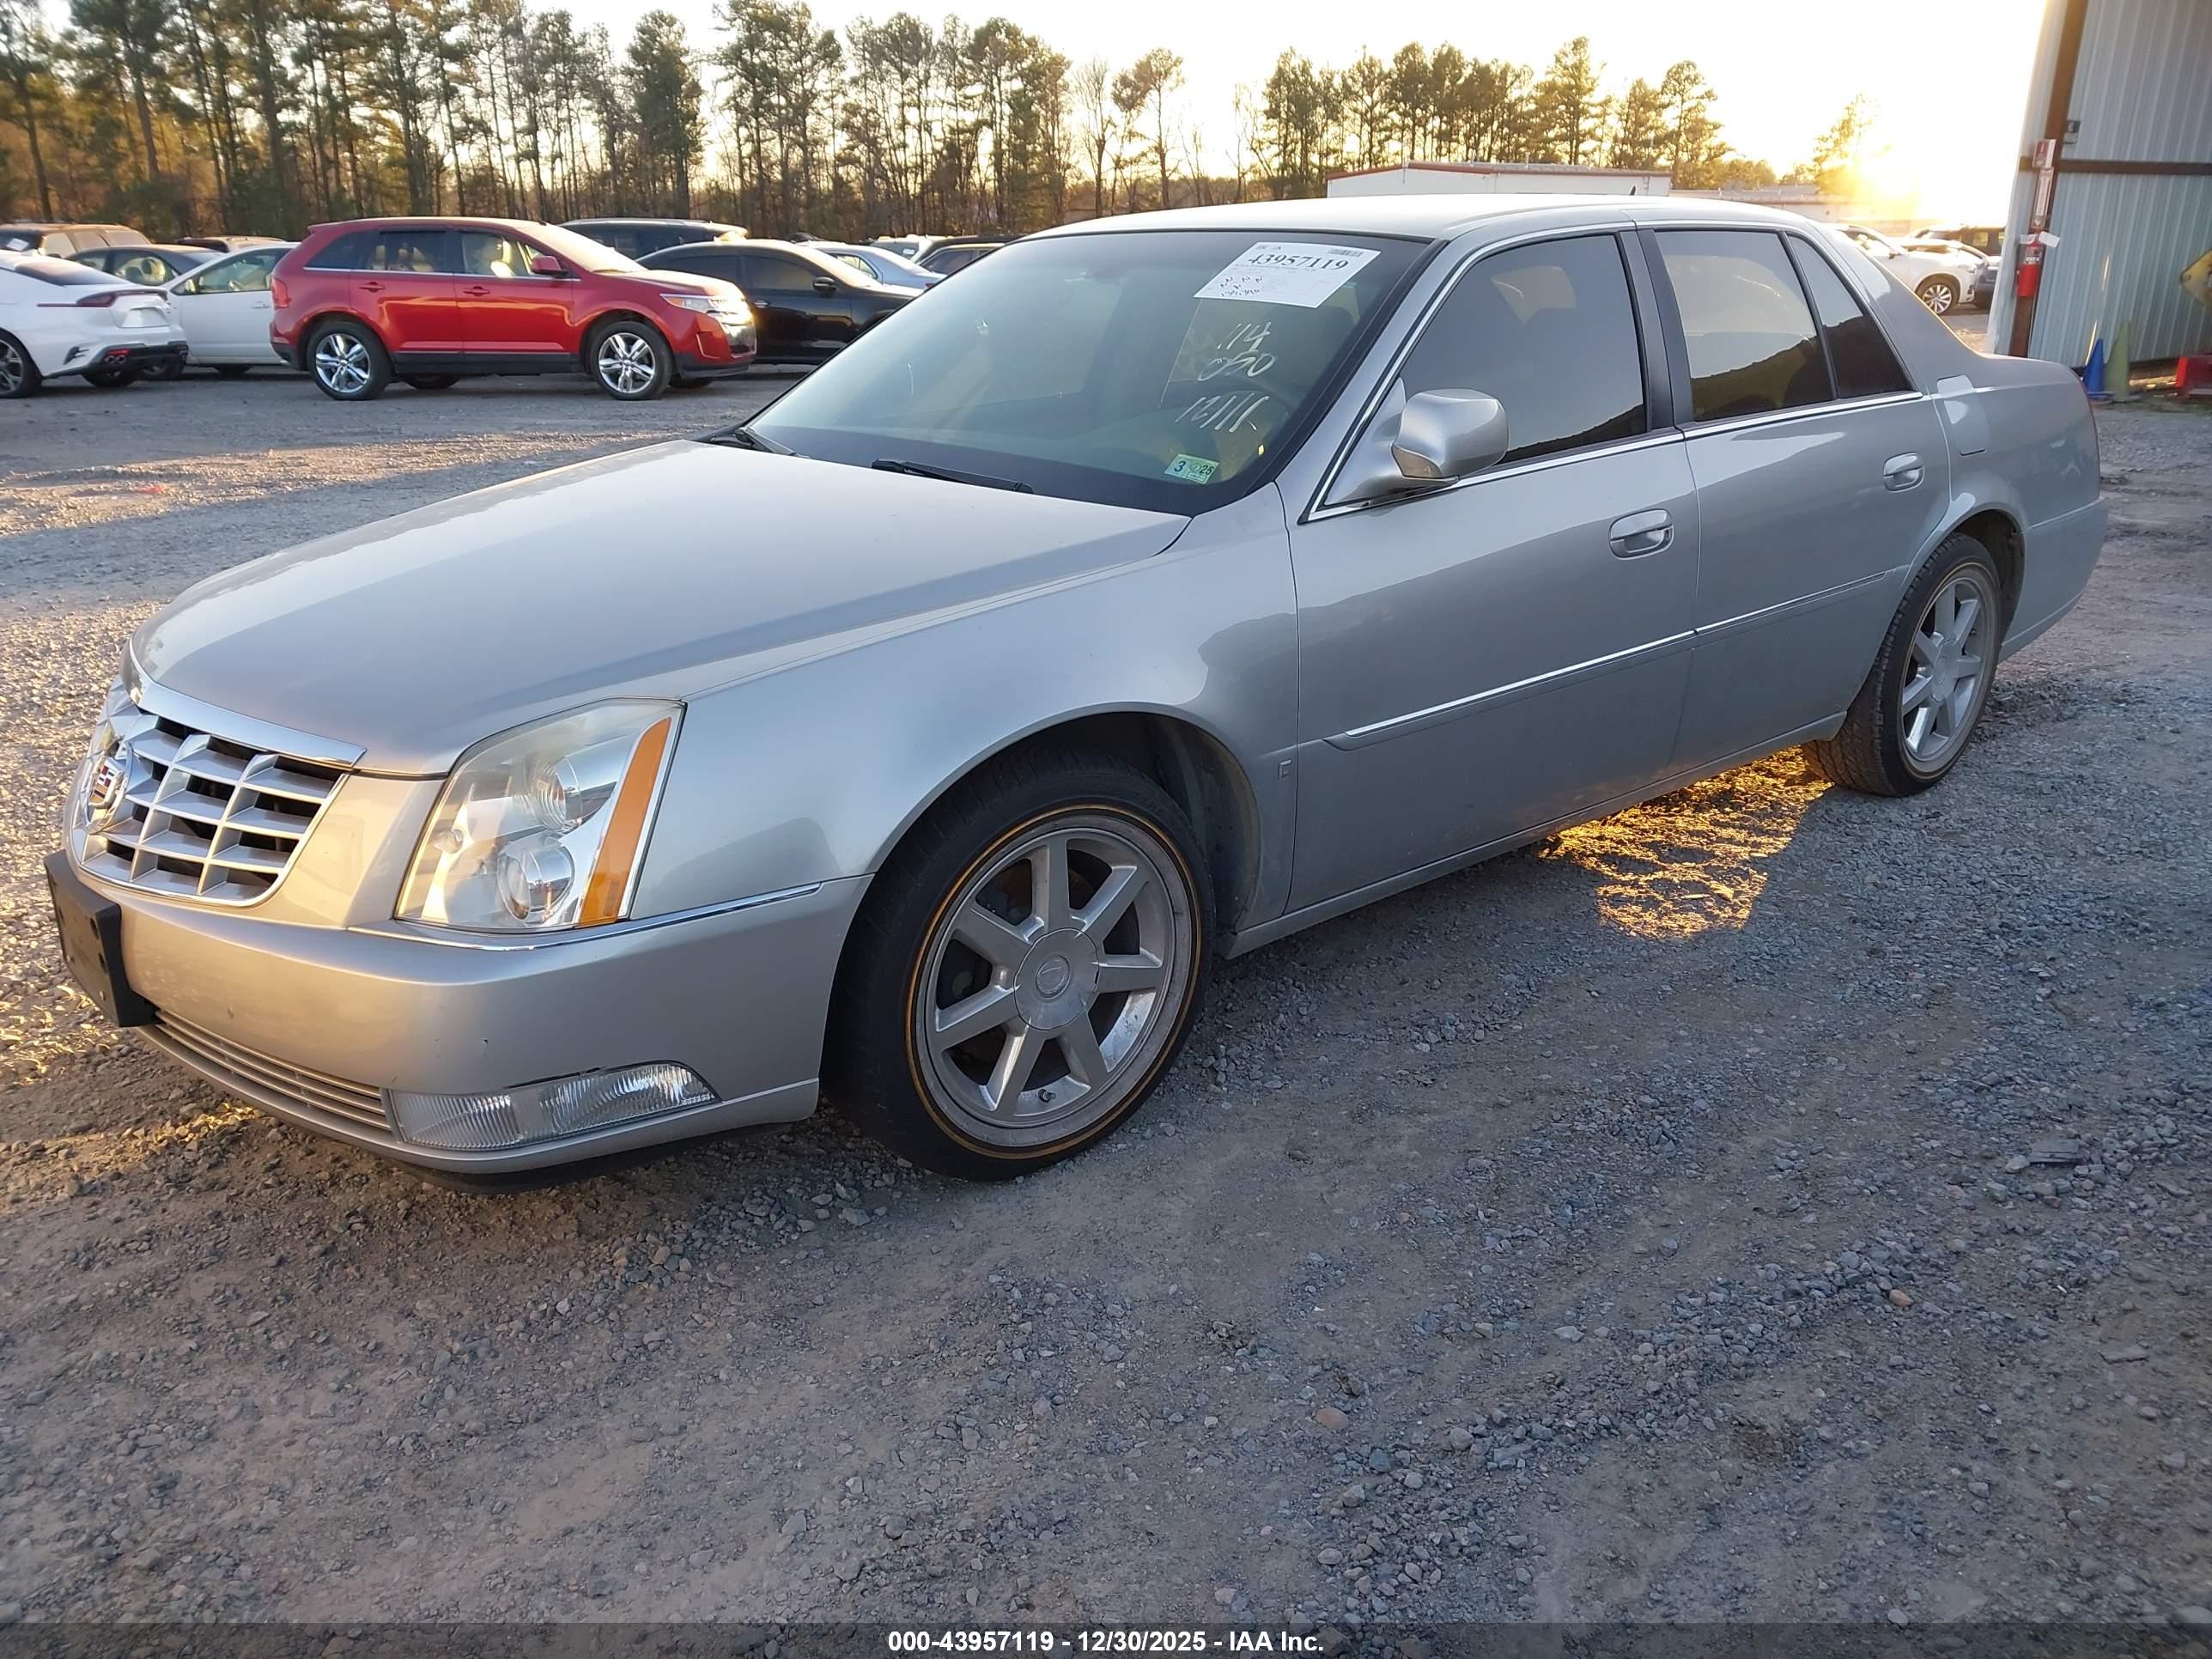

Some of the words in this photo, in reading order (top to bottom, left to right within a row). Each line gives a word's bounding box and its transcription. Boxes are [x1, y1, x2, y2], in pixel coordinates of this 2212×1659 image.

[1248, 253, 1349, 270] 43957119
[1174, 460, 1187, 472] 3
[1199, 465, 1214, 475] 25
